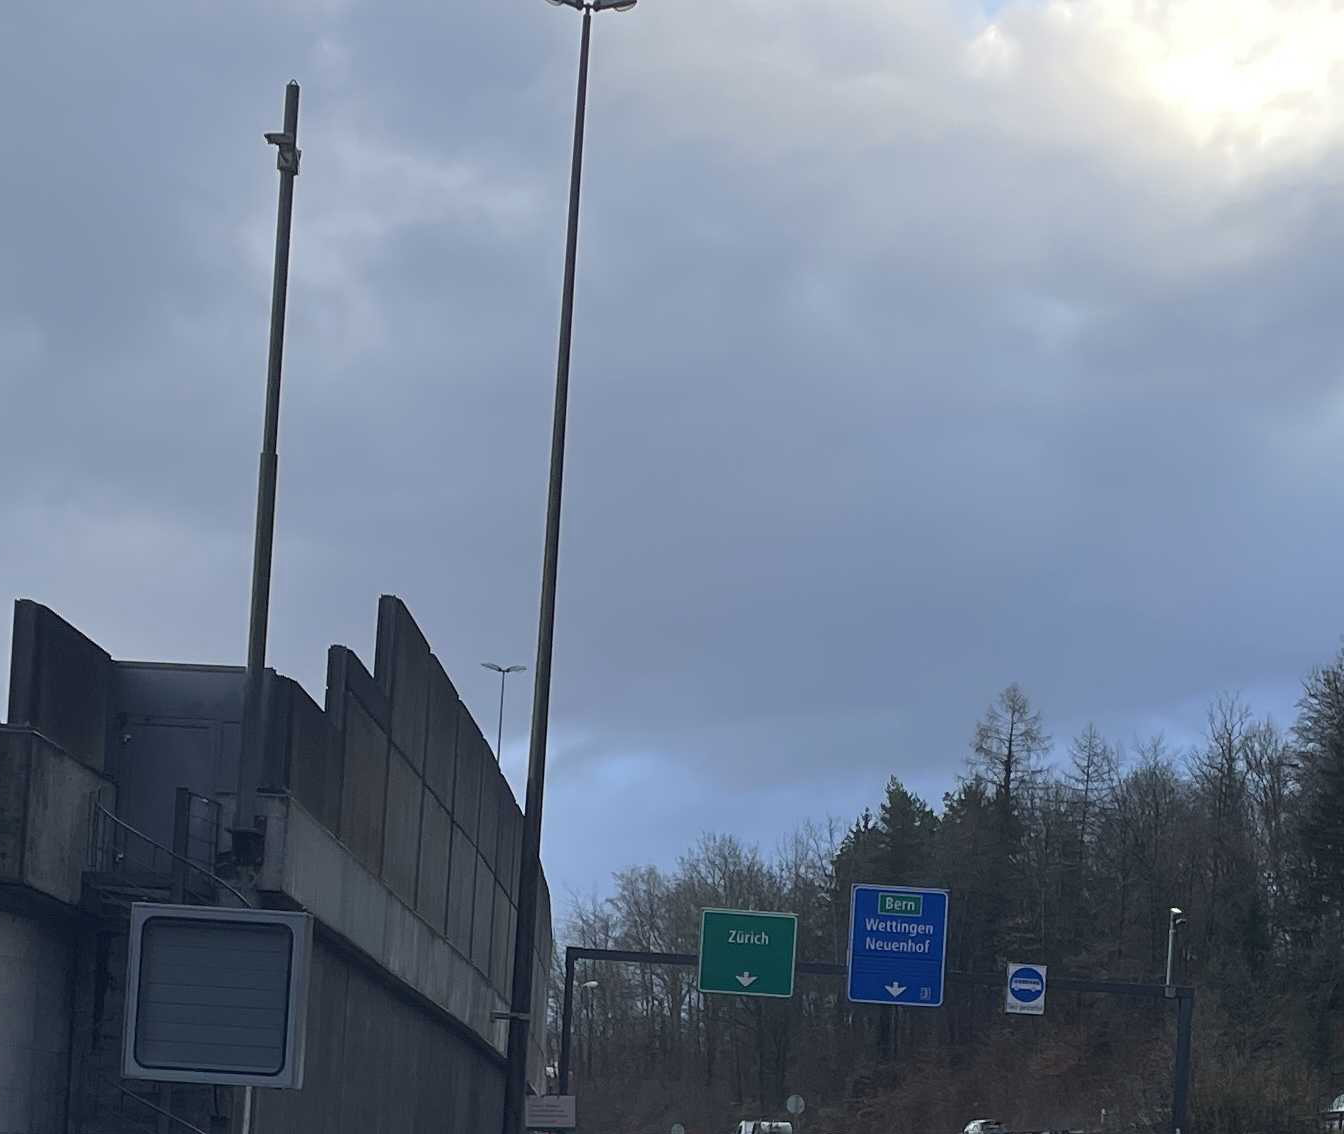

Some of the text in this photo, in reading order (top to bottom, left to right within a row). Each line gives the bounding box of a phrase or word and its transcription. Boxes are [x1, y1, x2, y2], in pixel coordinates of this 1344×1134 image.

[885, 896, 915, 911] Bern
[865, 917, 934, 937] Wettingen
[727, 929, 769, 945] Zürich
[865, 936, 931, 953] Neuenhof
